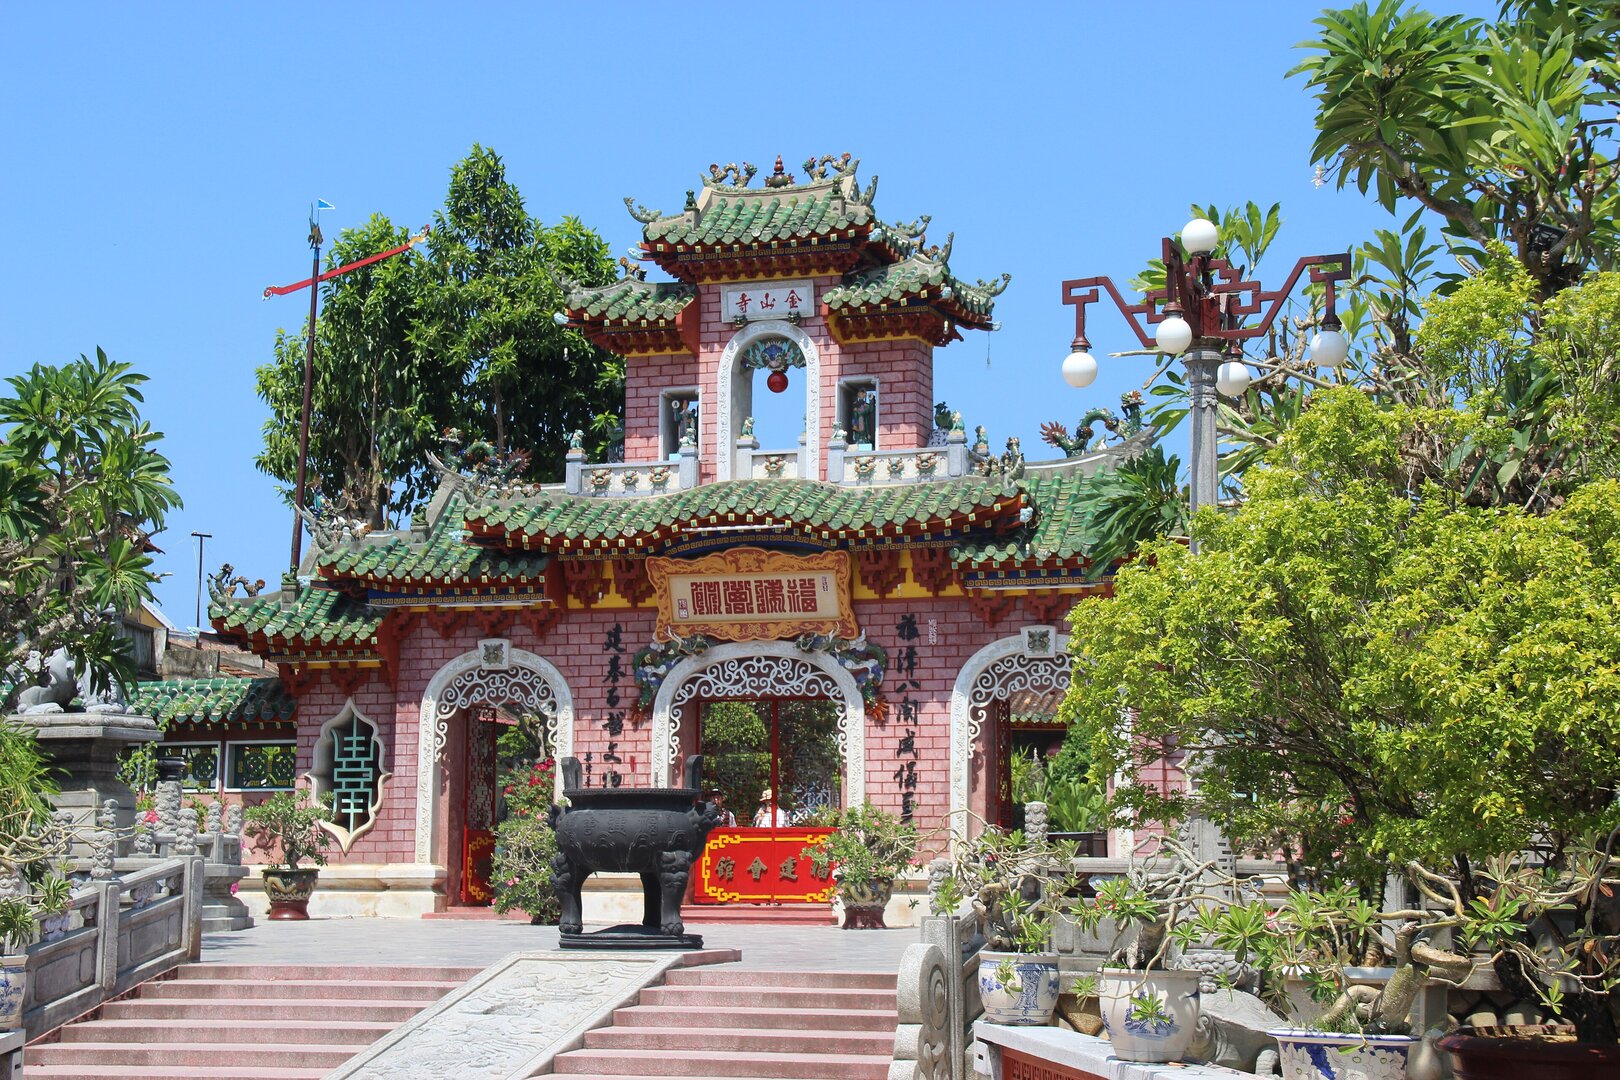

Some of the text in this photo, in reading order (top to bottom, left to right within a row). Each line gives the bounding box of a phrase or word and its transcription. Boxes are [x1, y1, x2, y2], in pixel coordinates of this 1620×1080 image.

[735, 289, 802, 313] 金山寺
[715, 856, 832, 881] 福建會館
